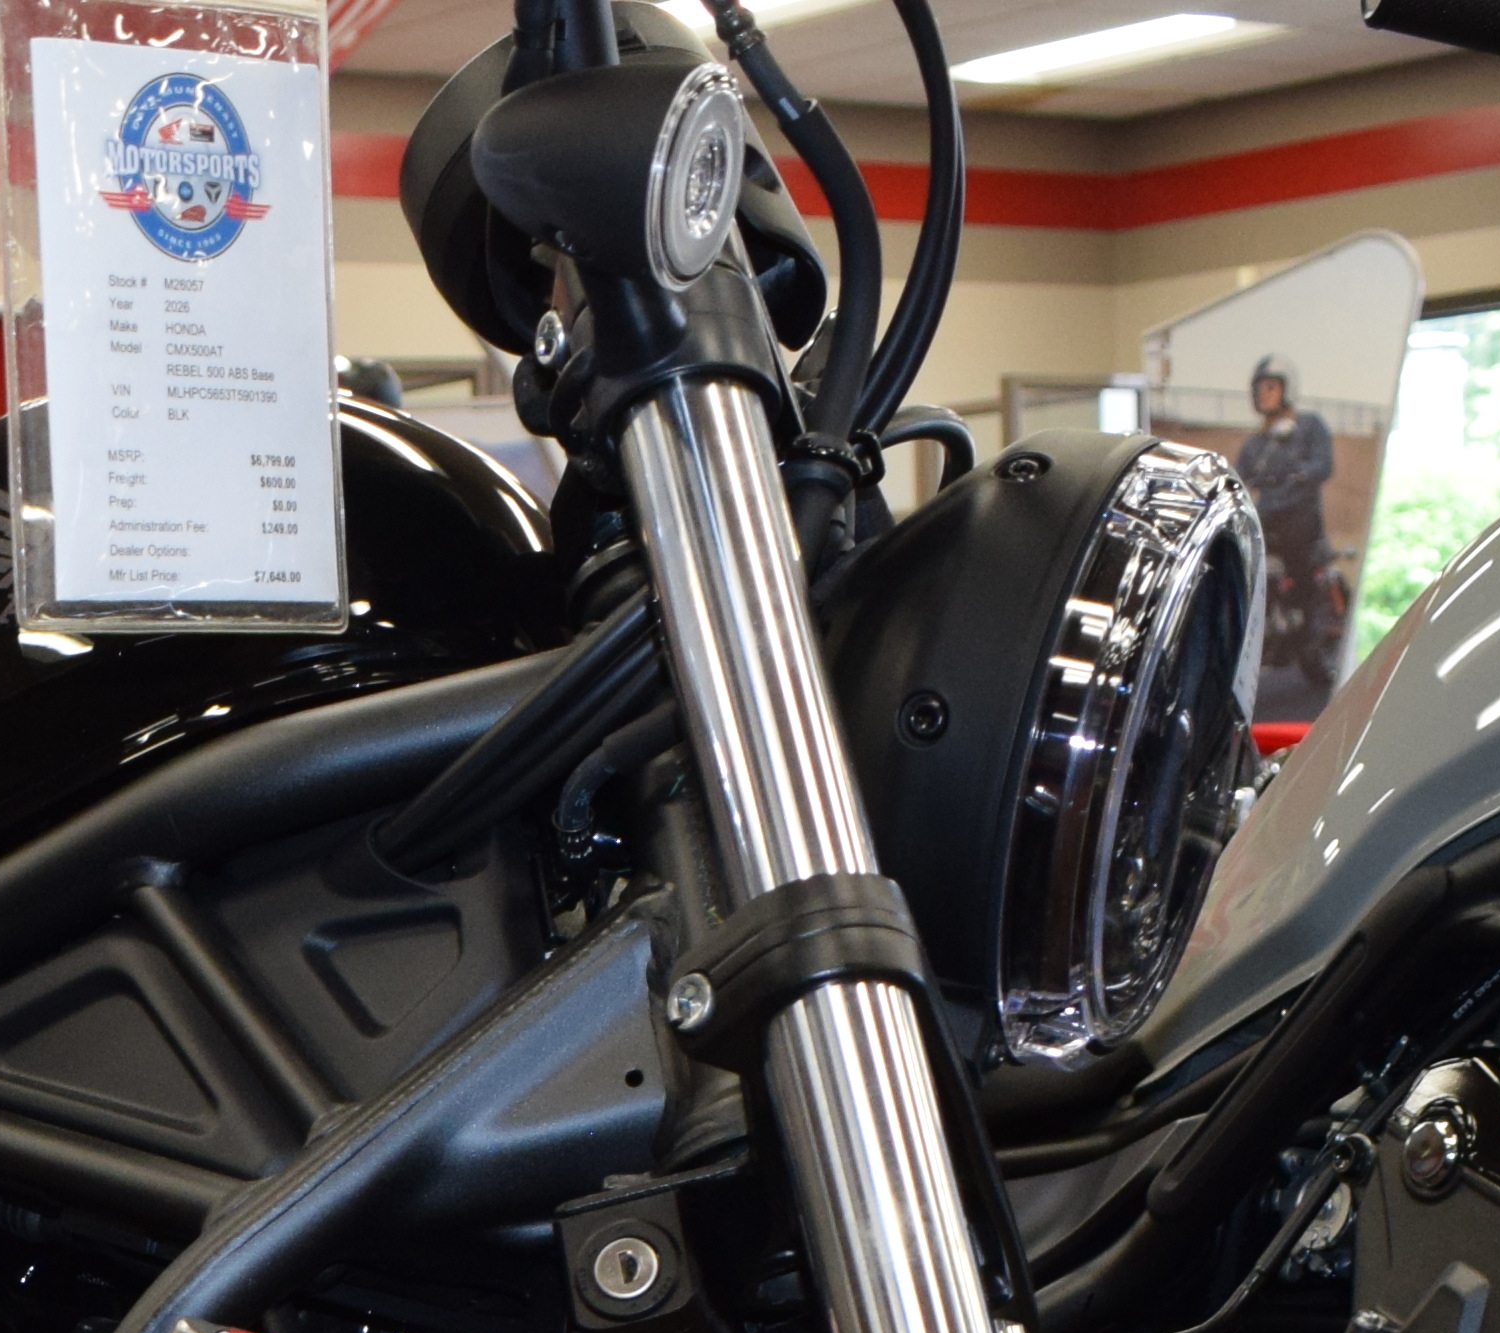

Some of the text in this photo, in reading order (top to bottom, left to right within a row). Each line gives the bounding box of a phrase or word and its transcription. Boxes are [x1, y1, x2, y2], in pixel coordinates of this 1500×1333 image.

[161, 85, 238, 138] MUNENAST
[107, 140, 261, 190] MOTORSPORTS
[108, 275, 136, 287] Stock
[140, 278, 147, 287] #
[109, 298, 190, 312] Year 2026
[110, 320, 206, 335] Make HONDA
[110, 341, 223, 356] Model CMX500AT
[166, 364, 274, 381] REBEL 500 ABS Base
[112, 385, 131, 396] VIN
[112, 406, 189, 420] Color BLK
[108, 450, 144, 462] MSRP:
[260, 476, 296, 488] $600.00
[273, 500, 297, 512] $0.00
[110, 520, 183, 532] Administration
[262, 523, 298, 534] $249.00
[110, 545, 144, 556] Dealer
[130, 570, 147, 581] List
